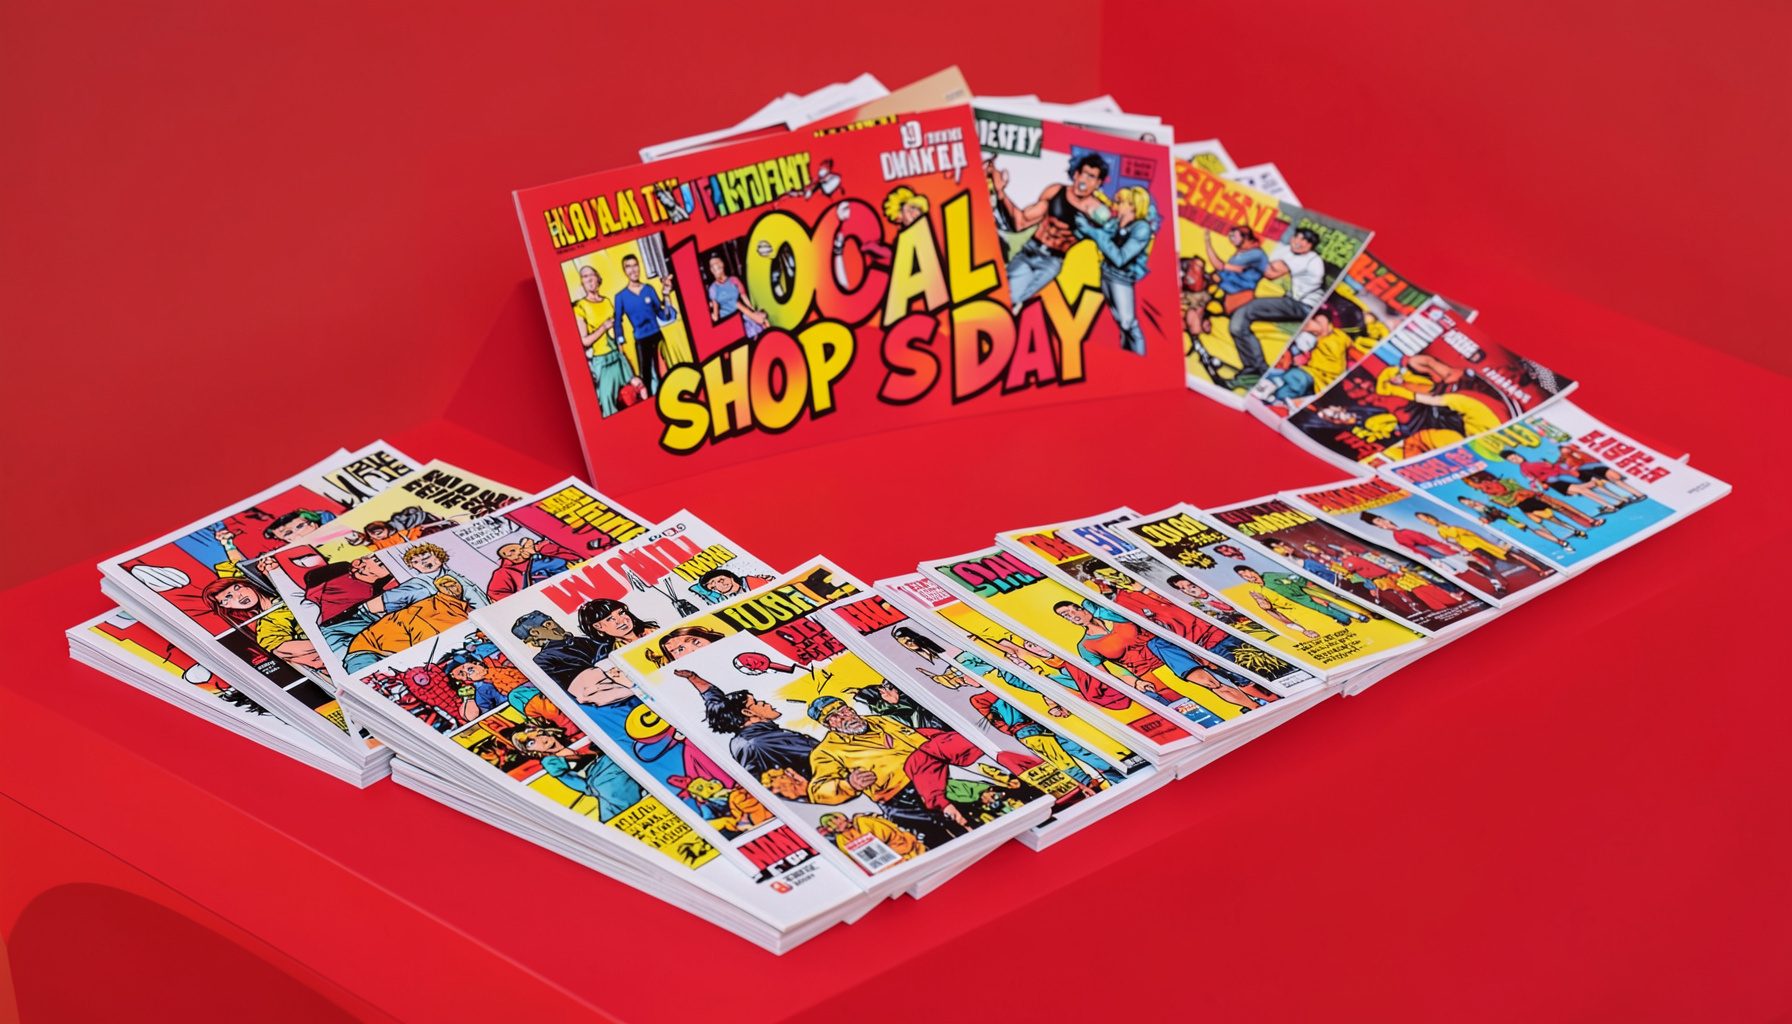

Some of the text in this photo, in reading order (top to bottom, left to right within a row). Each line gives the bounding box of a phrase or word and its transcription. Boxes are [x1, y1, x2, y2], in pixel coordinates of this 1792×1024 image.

[658, 270, 1104, 456] SHOP S DAY
[668, 191, 1002, 361] LOCAL
